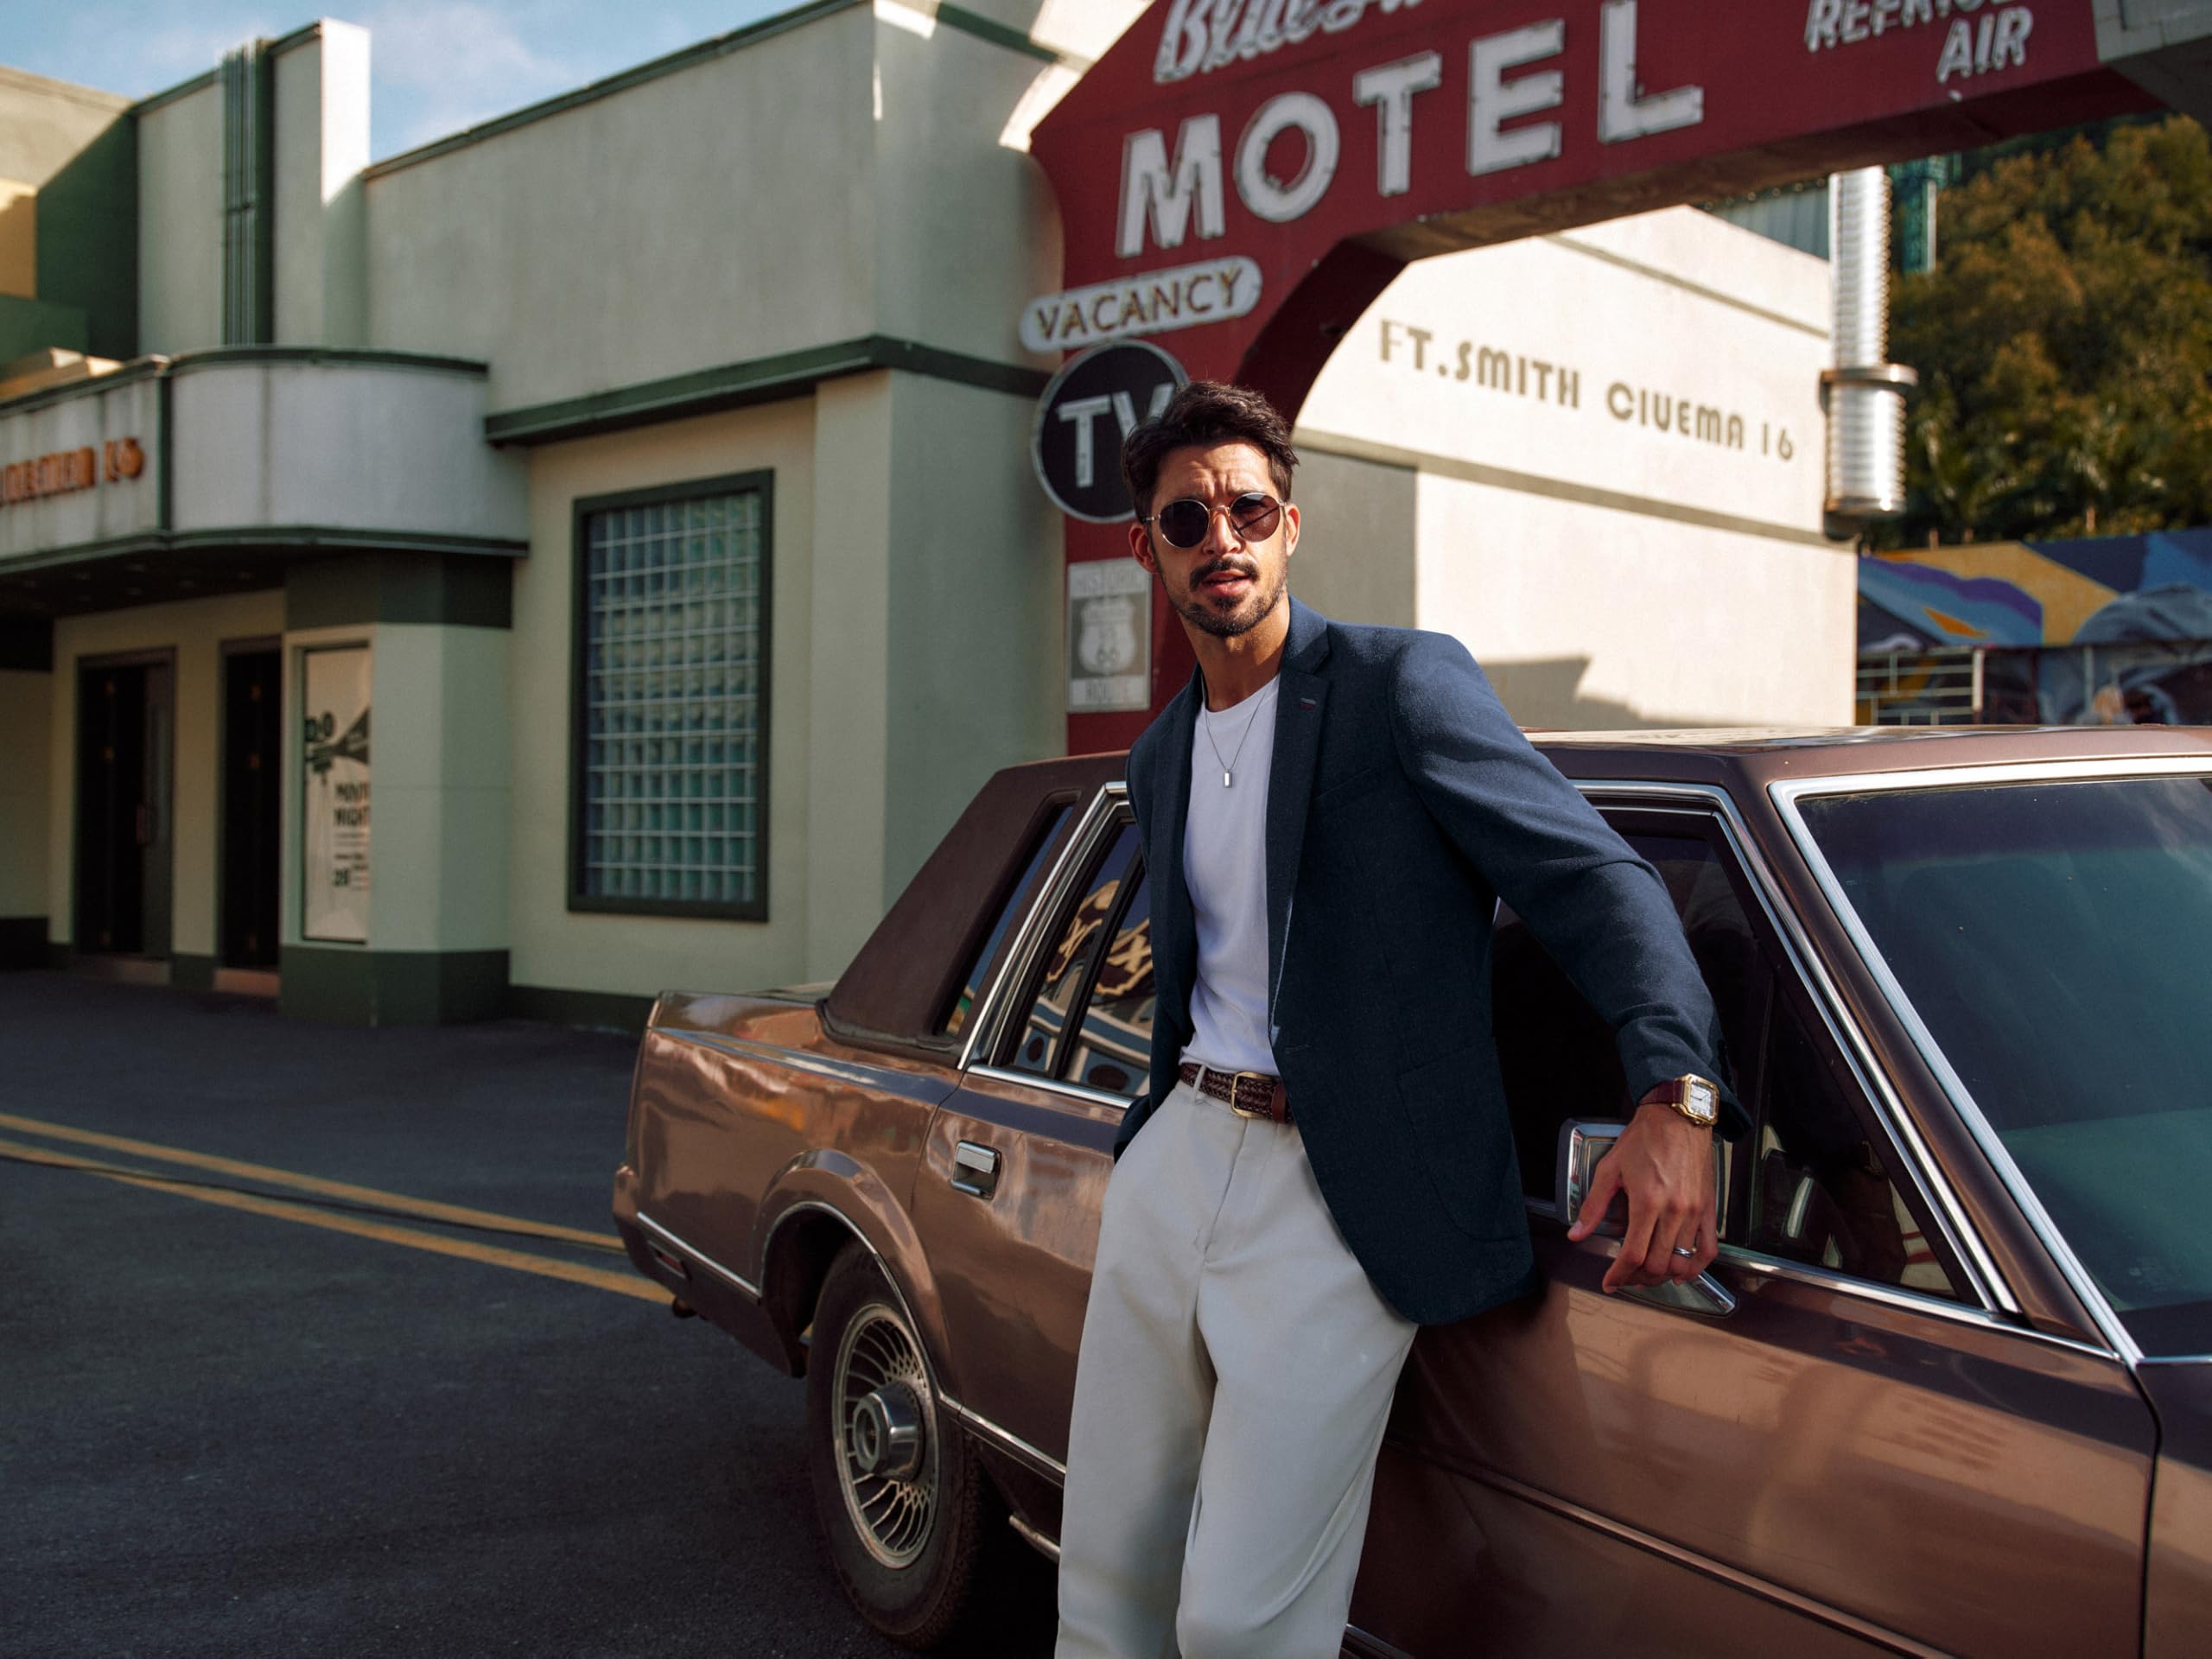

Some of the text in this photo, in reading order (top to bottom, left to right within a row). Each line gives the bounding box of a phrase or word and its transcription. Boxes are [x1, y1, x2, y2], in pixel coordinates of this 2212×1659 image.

[1936, 6, 2033, 84] AIR
[1115, 2, 1705, 258] MOTEL
[1035, 264, 1243, 341] VACANCY
[1760, 421, 1794, 461] 16
